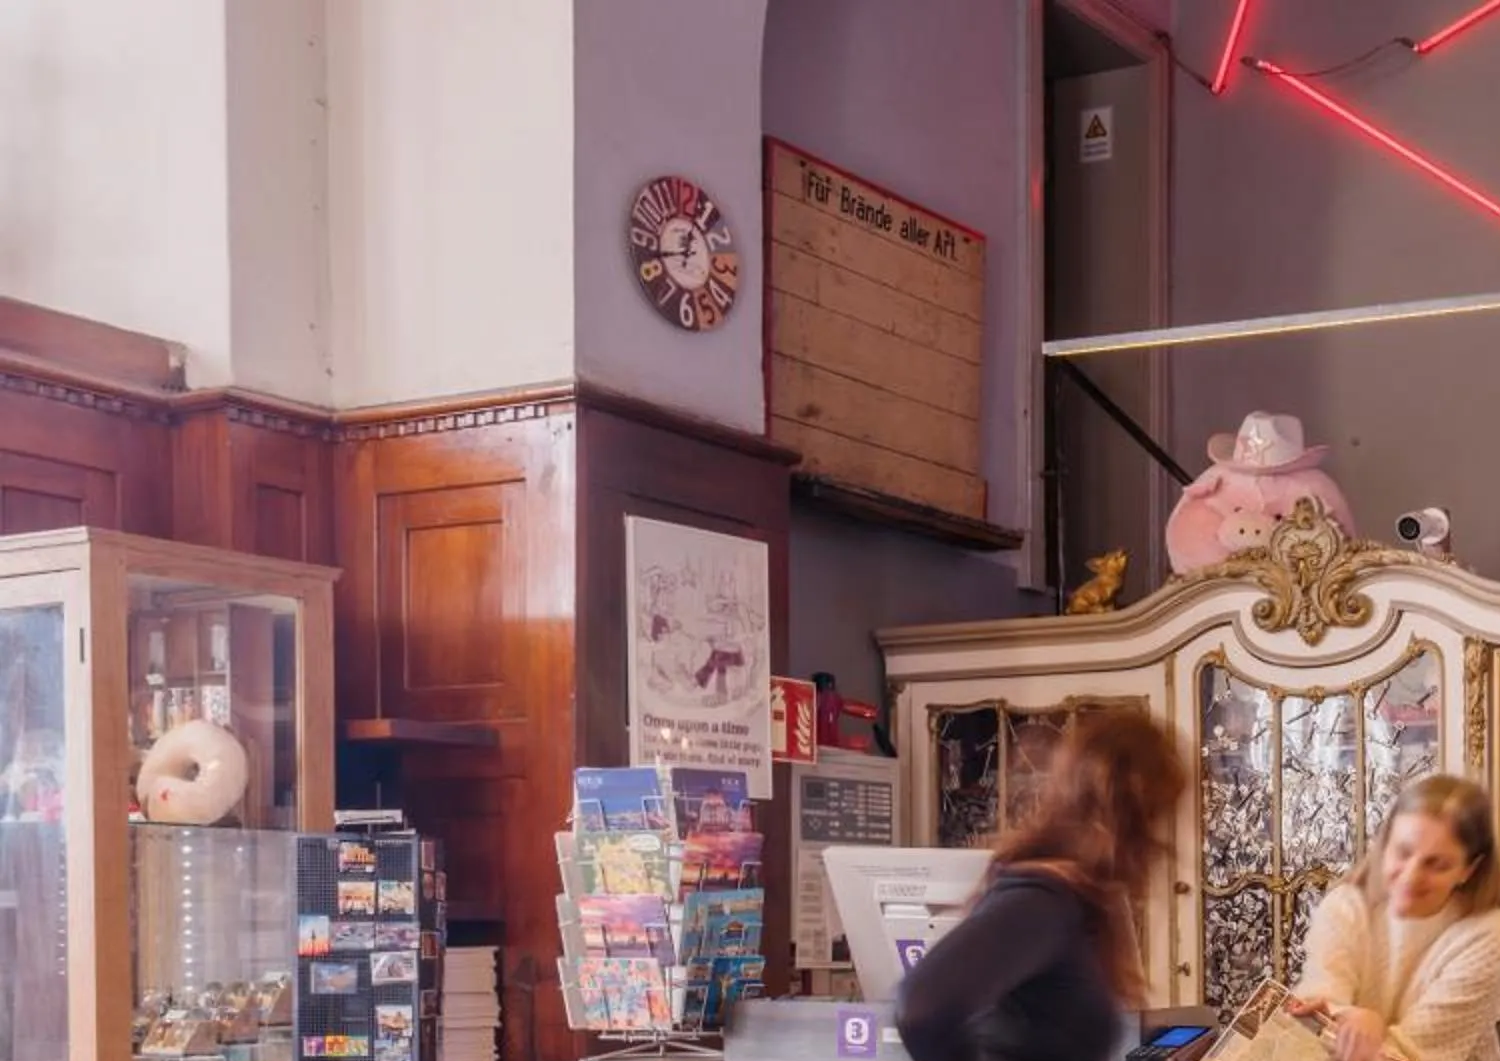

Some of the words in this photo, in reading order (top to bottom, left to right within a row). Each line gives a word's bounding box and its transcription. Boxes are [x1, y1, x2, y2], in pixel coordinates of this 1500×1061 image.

[697, 201, 713, 231] 1
[840, 186, 893, 232] Brände
[900, 216, 930, 247] aller
[631, 227, 658, 251] 9
[707, 227, 732, 251] 2
[640, 258, 662, 282] 8
[711, 256, 738, 277] 3
[660, 278, 677, 305] 7
[709, 279, 733, 307] 4
[679, 293, 694, 328] 6
[698, 292, 715, 325] 5
[677, 719, 710, 734] upon
[711, 722, 719, 733] a
